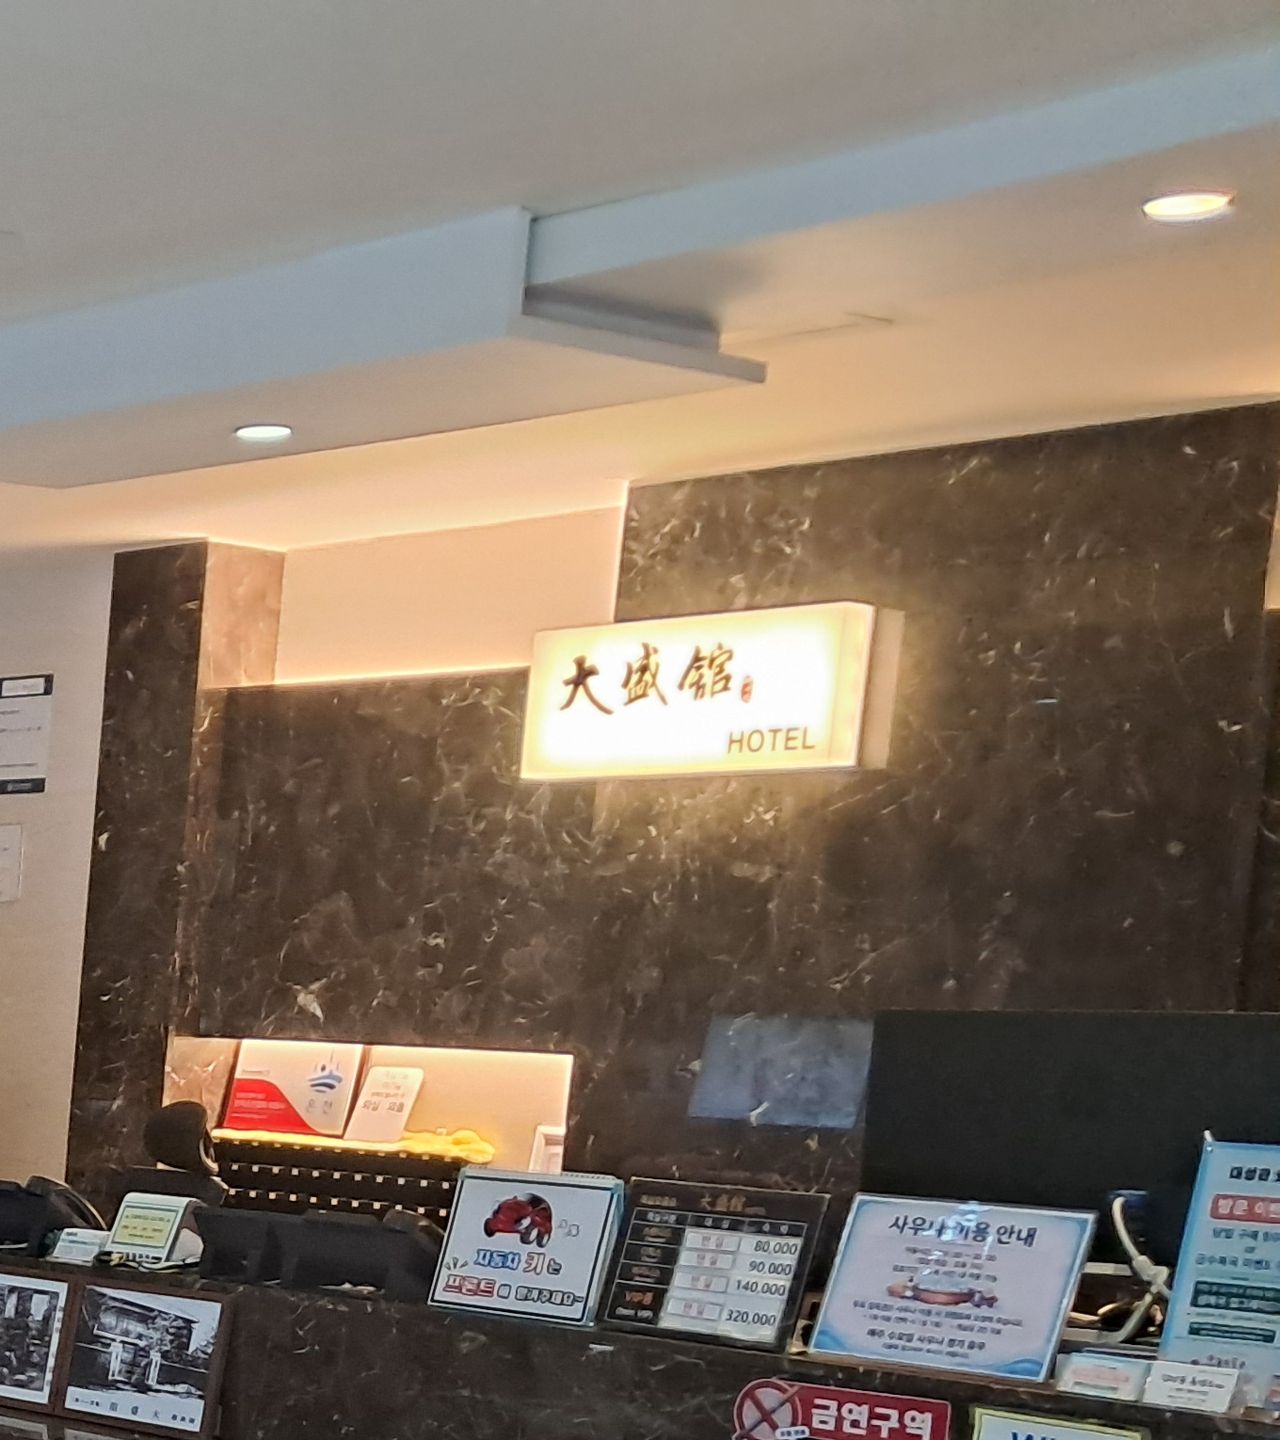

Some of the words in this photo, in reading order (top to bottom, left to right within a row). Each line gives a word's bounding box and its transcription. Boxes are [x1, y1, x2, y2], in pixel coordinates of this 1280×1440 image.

[560, 642, 735, 715] 大盛館
[727, 727, 817, 754] HOTEL
[889, 1215, 946, 1239] 사우나
[996, 1224, 1038, 1248] 안내
[754, 1240, 798, 1255] 80,000
[474, 1248, 521, 1271] 자동차
[523, 1252, 546, 1275] 키
[749, 1260, 792, 1276] 90,000
[443, 1273, 496, 1297] 프론트
[736, 1279, 786, 1296] 140,000
[726, 1310, 776, 1327] 320,000
